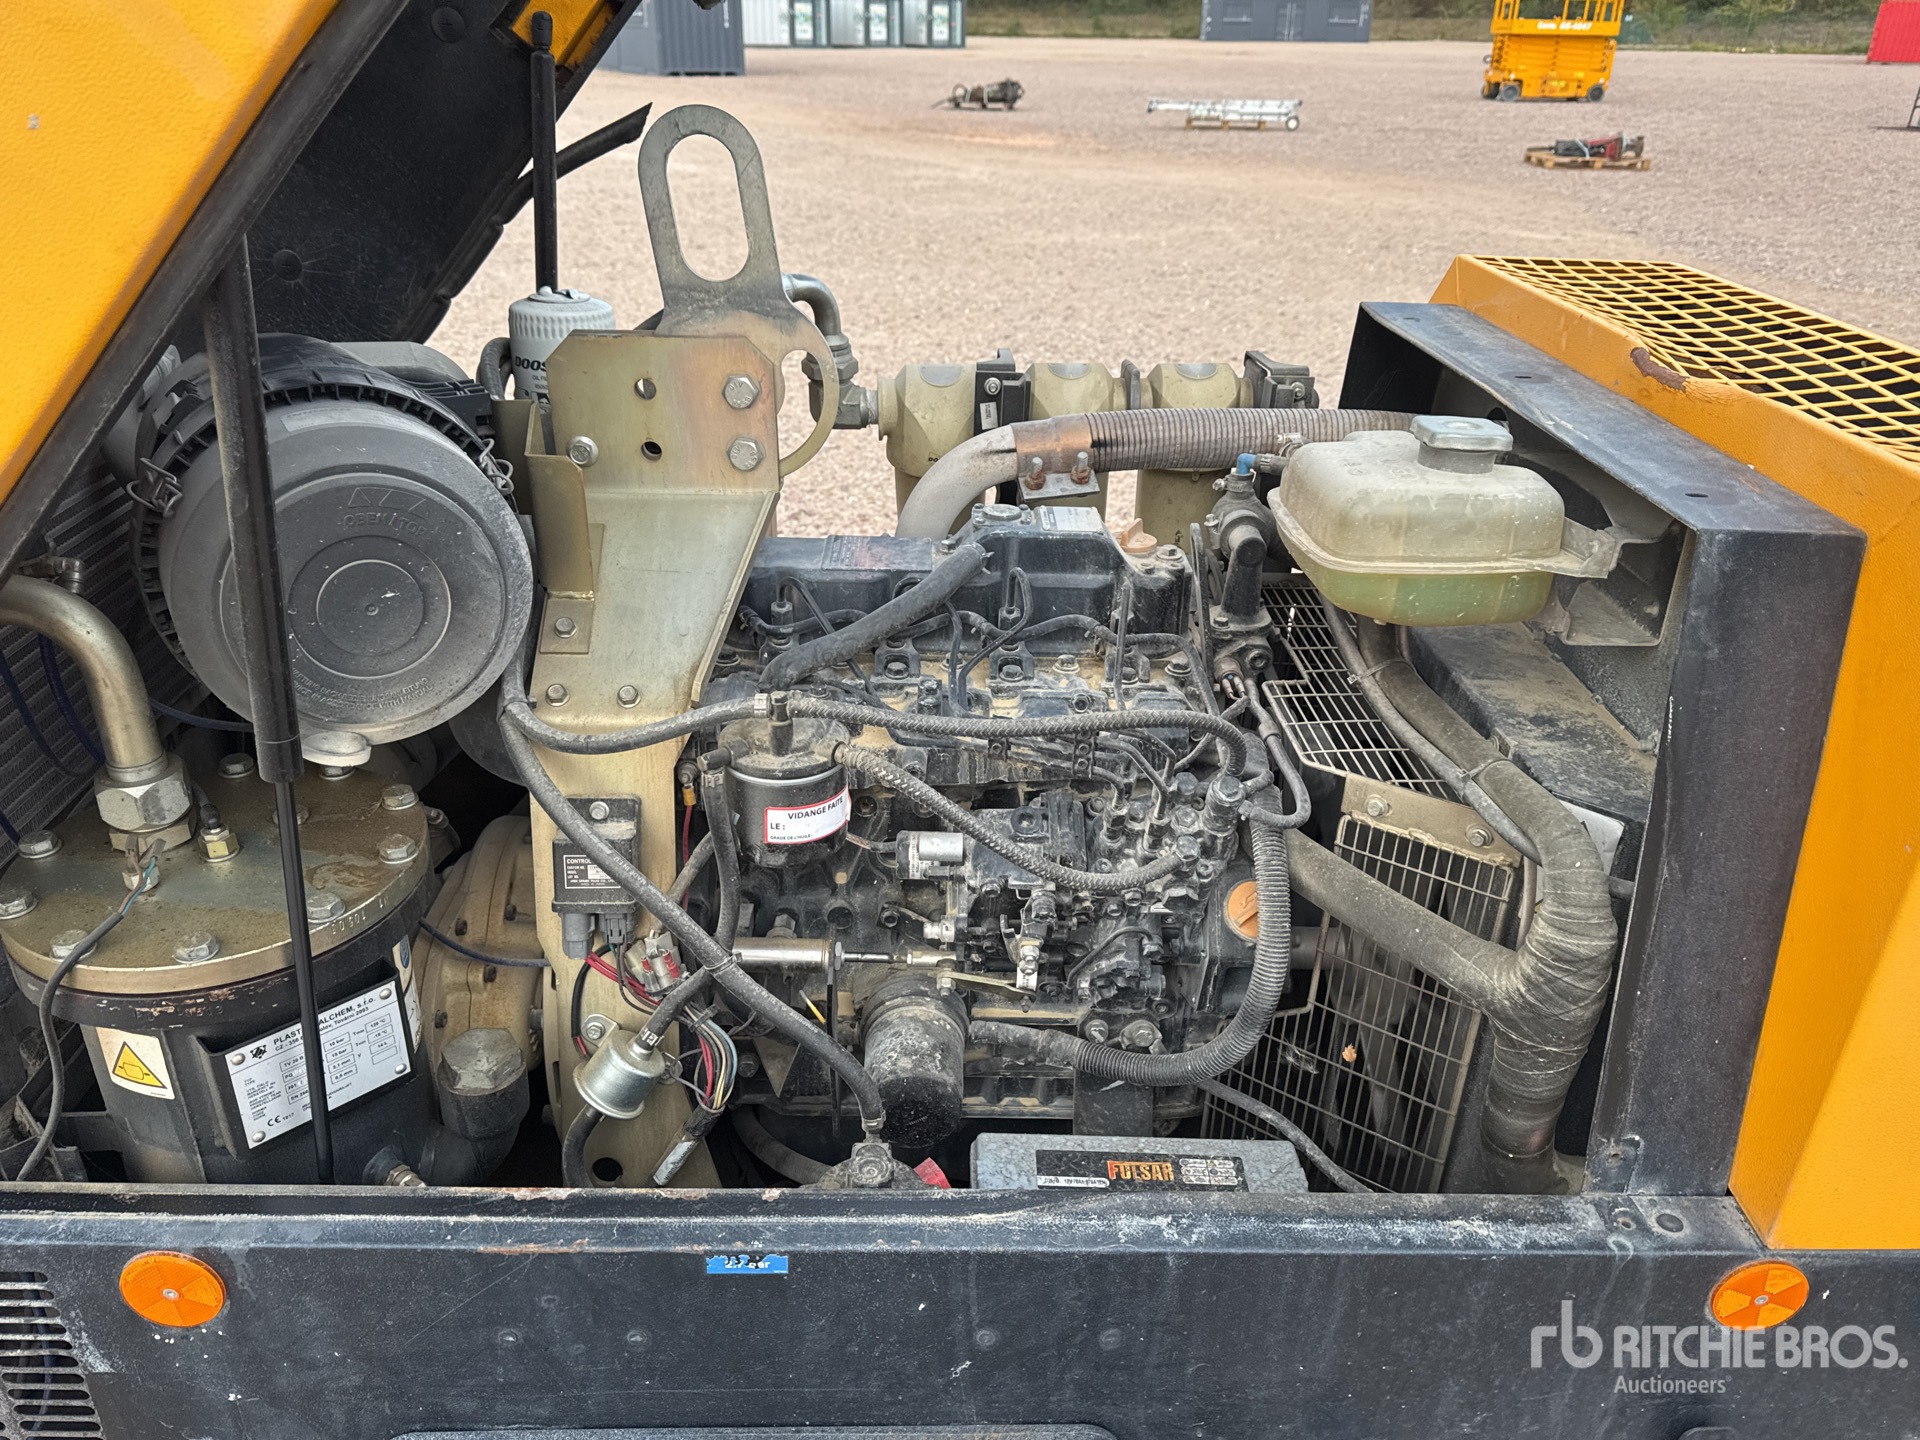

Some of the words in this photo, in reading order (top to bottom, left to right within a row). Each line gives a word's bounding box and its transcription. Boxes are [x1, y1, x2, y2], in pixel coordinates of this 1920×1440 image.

[515, 355, 546, 372] DOOS
[788, 807, 827, 820] VIDANGE
[827, 796, 843, 811] FAITE
[318, 1005, 355, 1025] ALCHEM,
